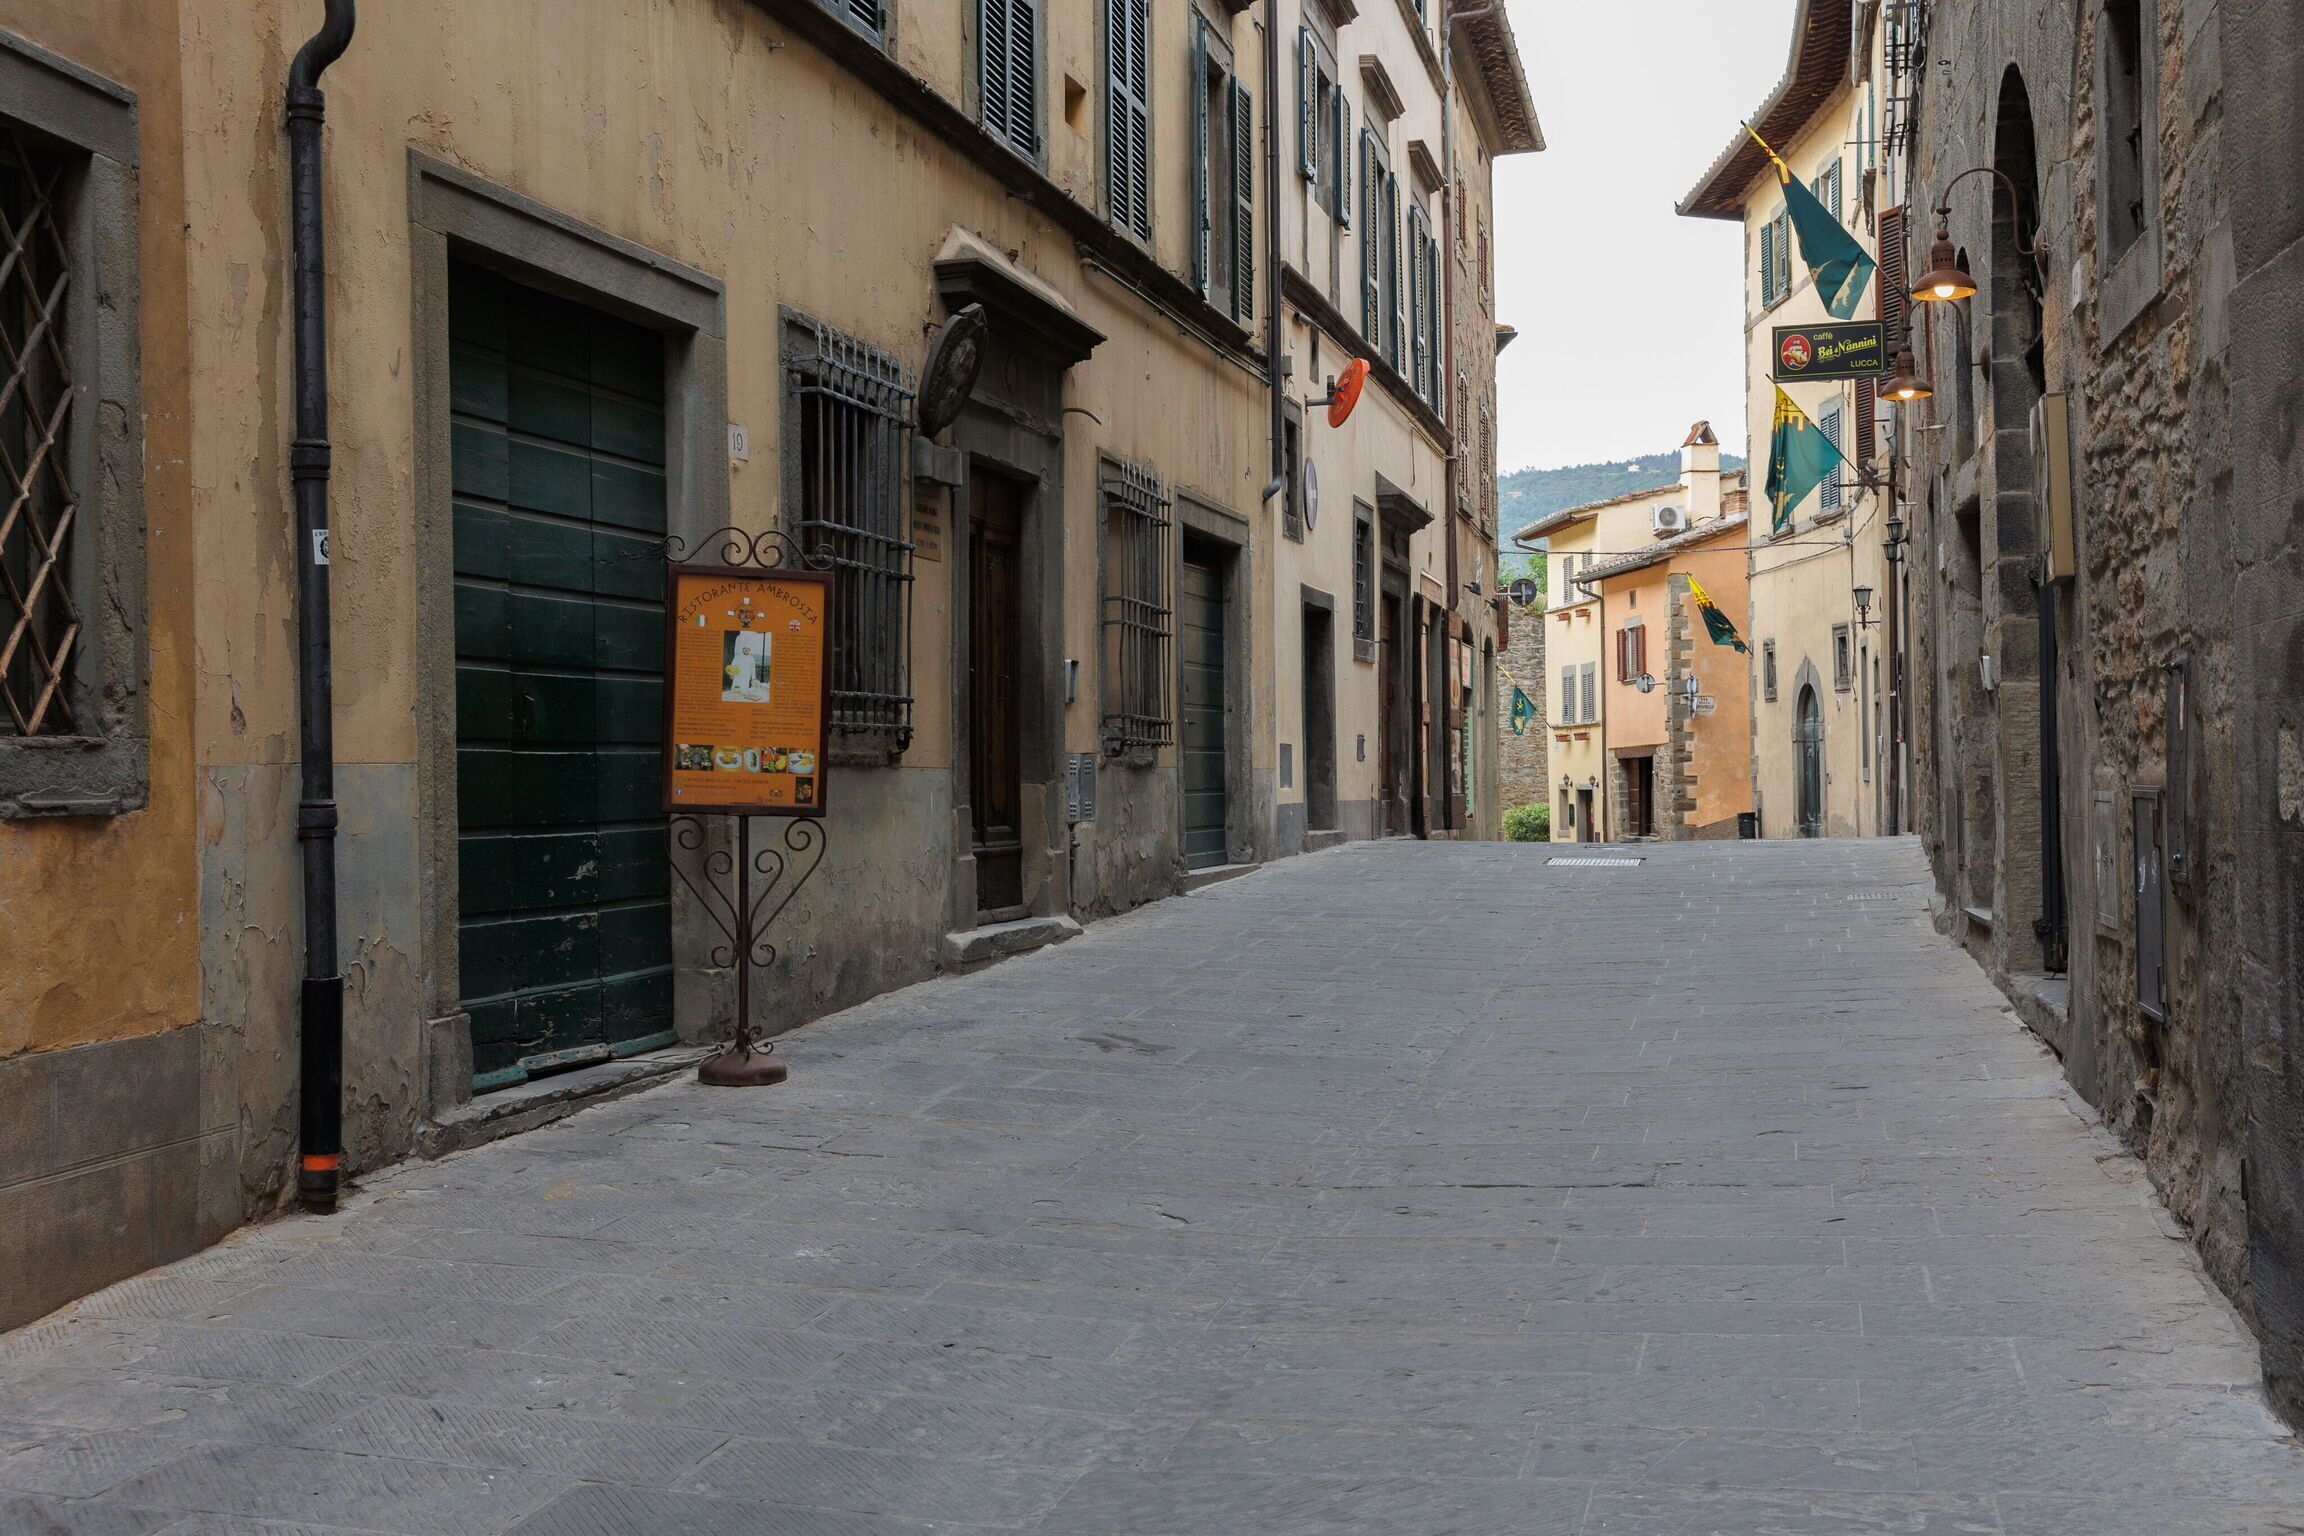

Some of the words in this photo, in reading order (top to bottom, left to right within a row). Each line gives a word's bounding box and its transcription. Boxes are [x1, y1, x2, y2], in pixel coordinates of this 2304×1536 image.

[1813, 332, 1833, 341] caffè
[1817, 345, 1833, 358] Bei
[1838, 335, 1877, 357] Nannini
[1850, 360, 1878, 368] LUCCA
[733, 433, 743, 452] 19
[678, 581, 752, 624] RISTORANTE
[757, 583, 818, 625] AMBROSIA
